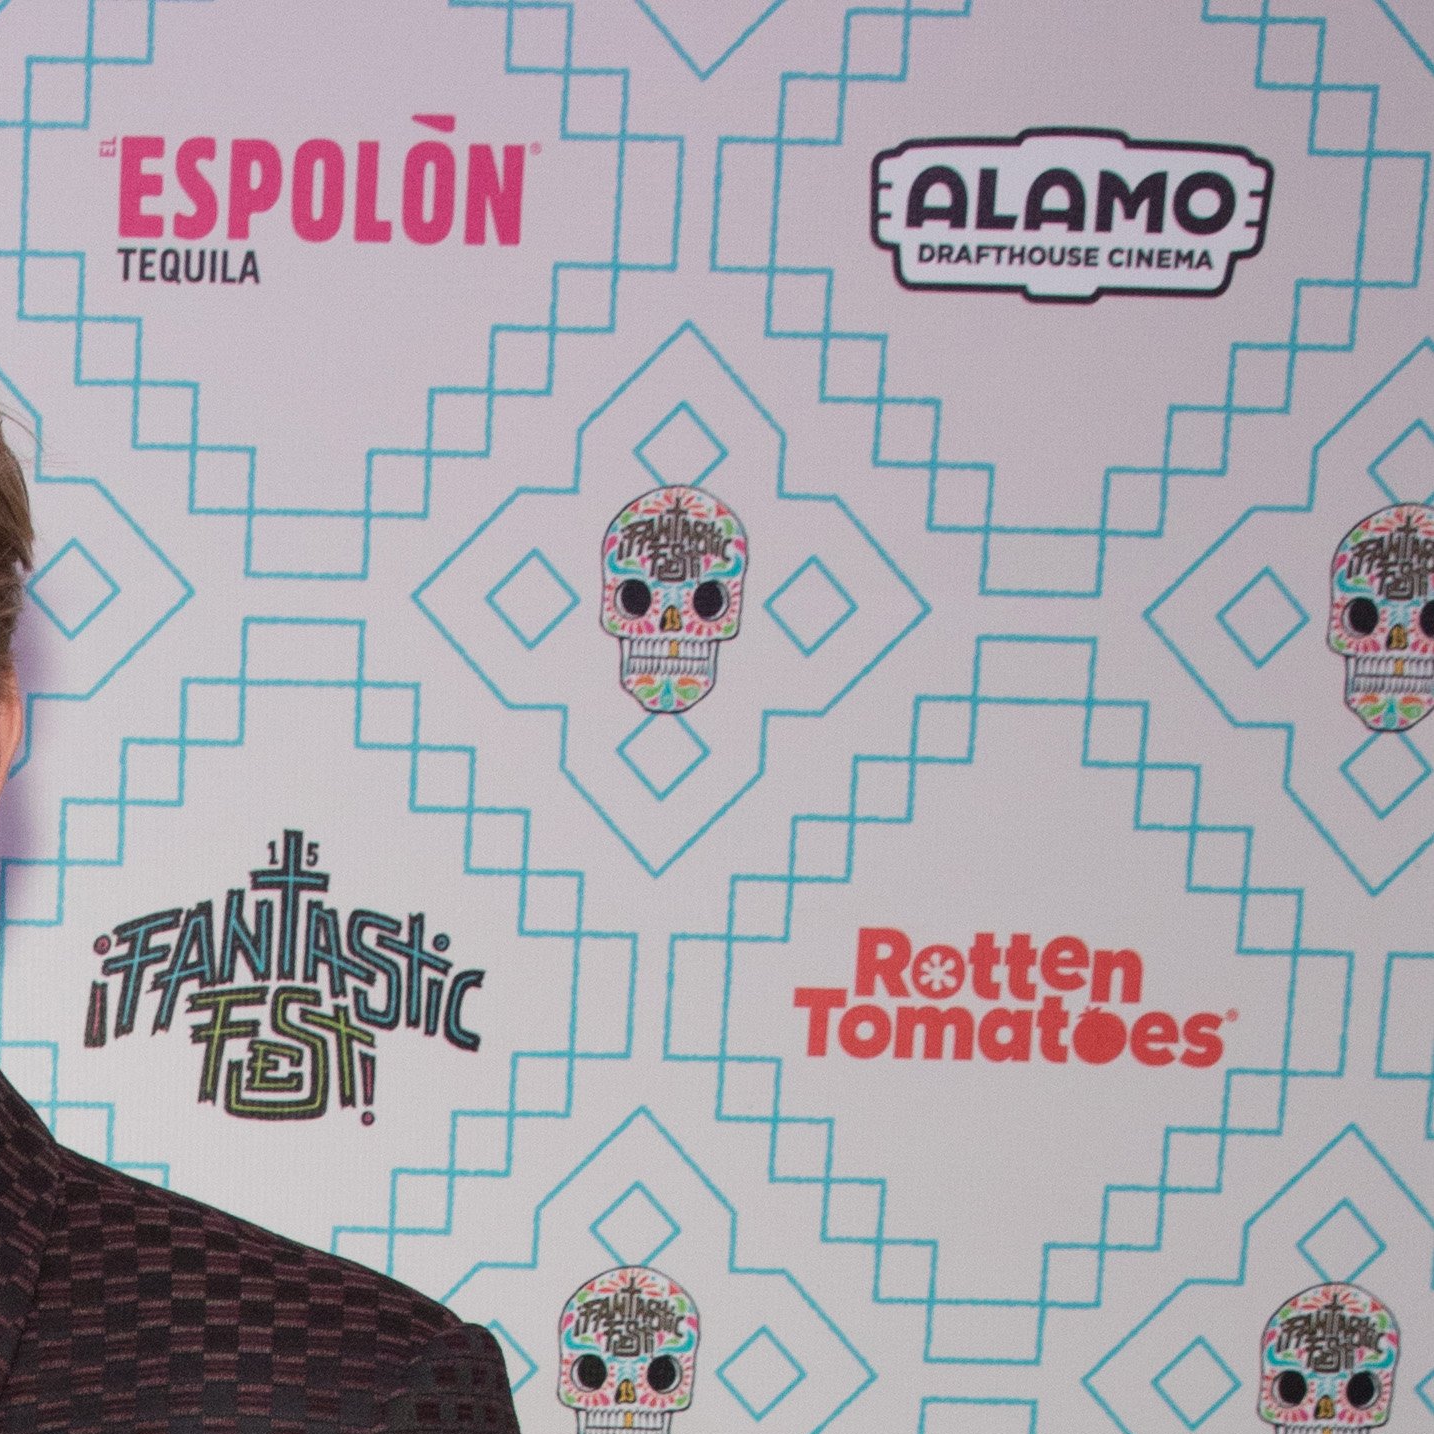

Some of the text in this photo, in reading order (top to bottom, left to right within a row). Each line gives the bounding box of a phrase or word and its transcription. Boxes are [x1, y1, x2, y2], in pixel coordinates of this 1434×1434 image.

[906, 166, 1237, 236] ALAMO
[118, 249, 261, 285] TEQUILA
[918, 244, 1214, 270] DRAFTHOUSE CINEMA
[854, 927, 1143, 1003] Rotten
[793, 987, 1225, 1068] Tomatoes
